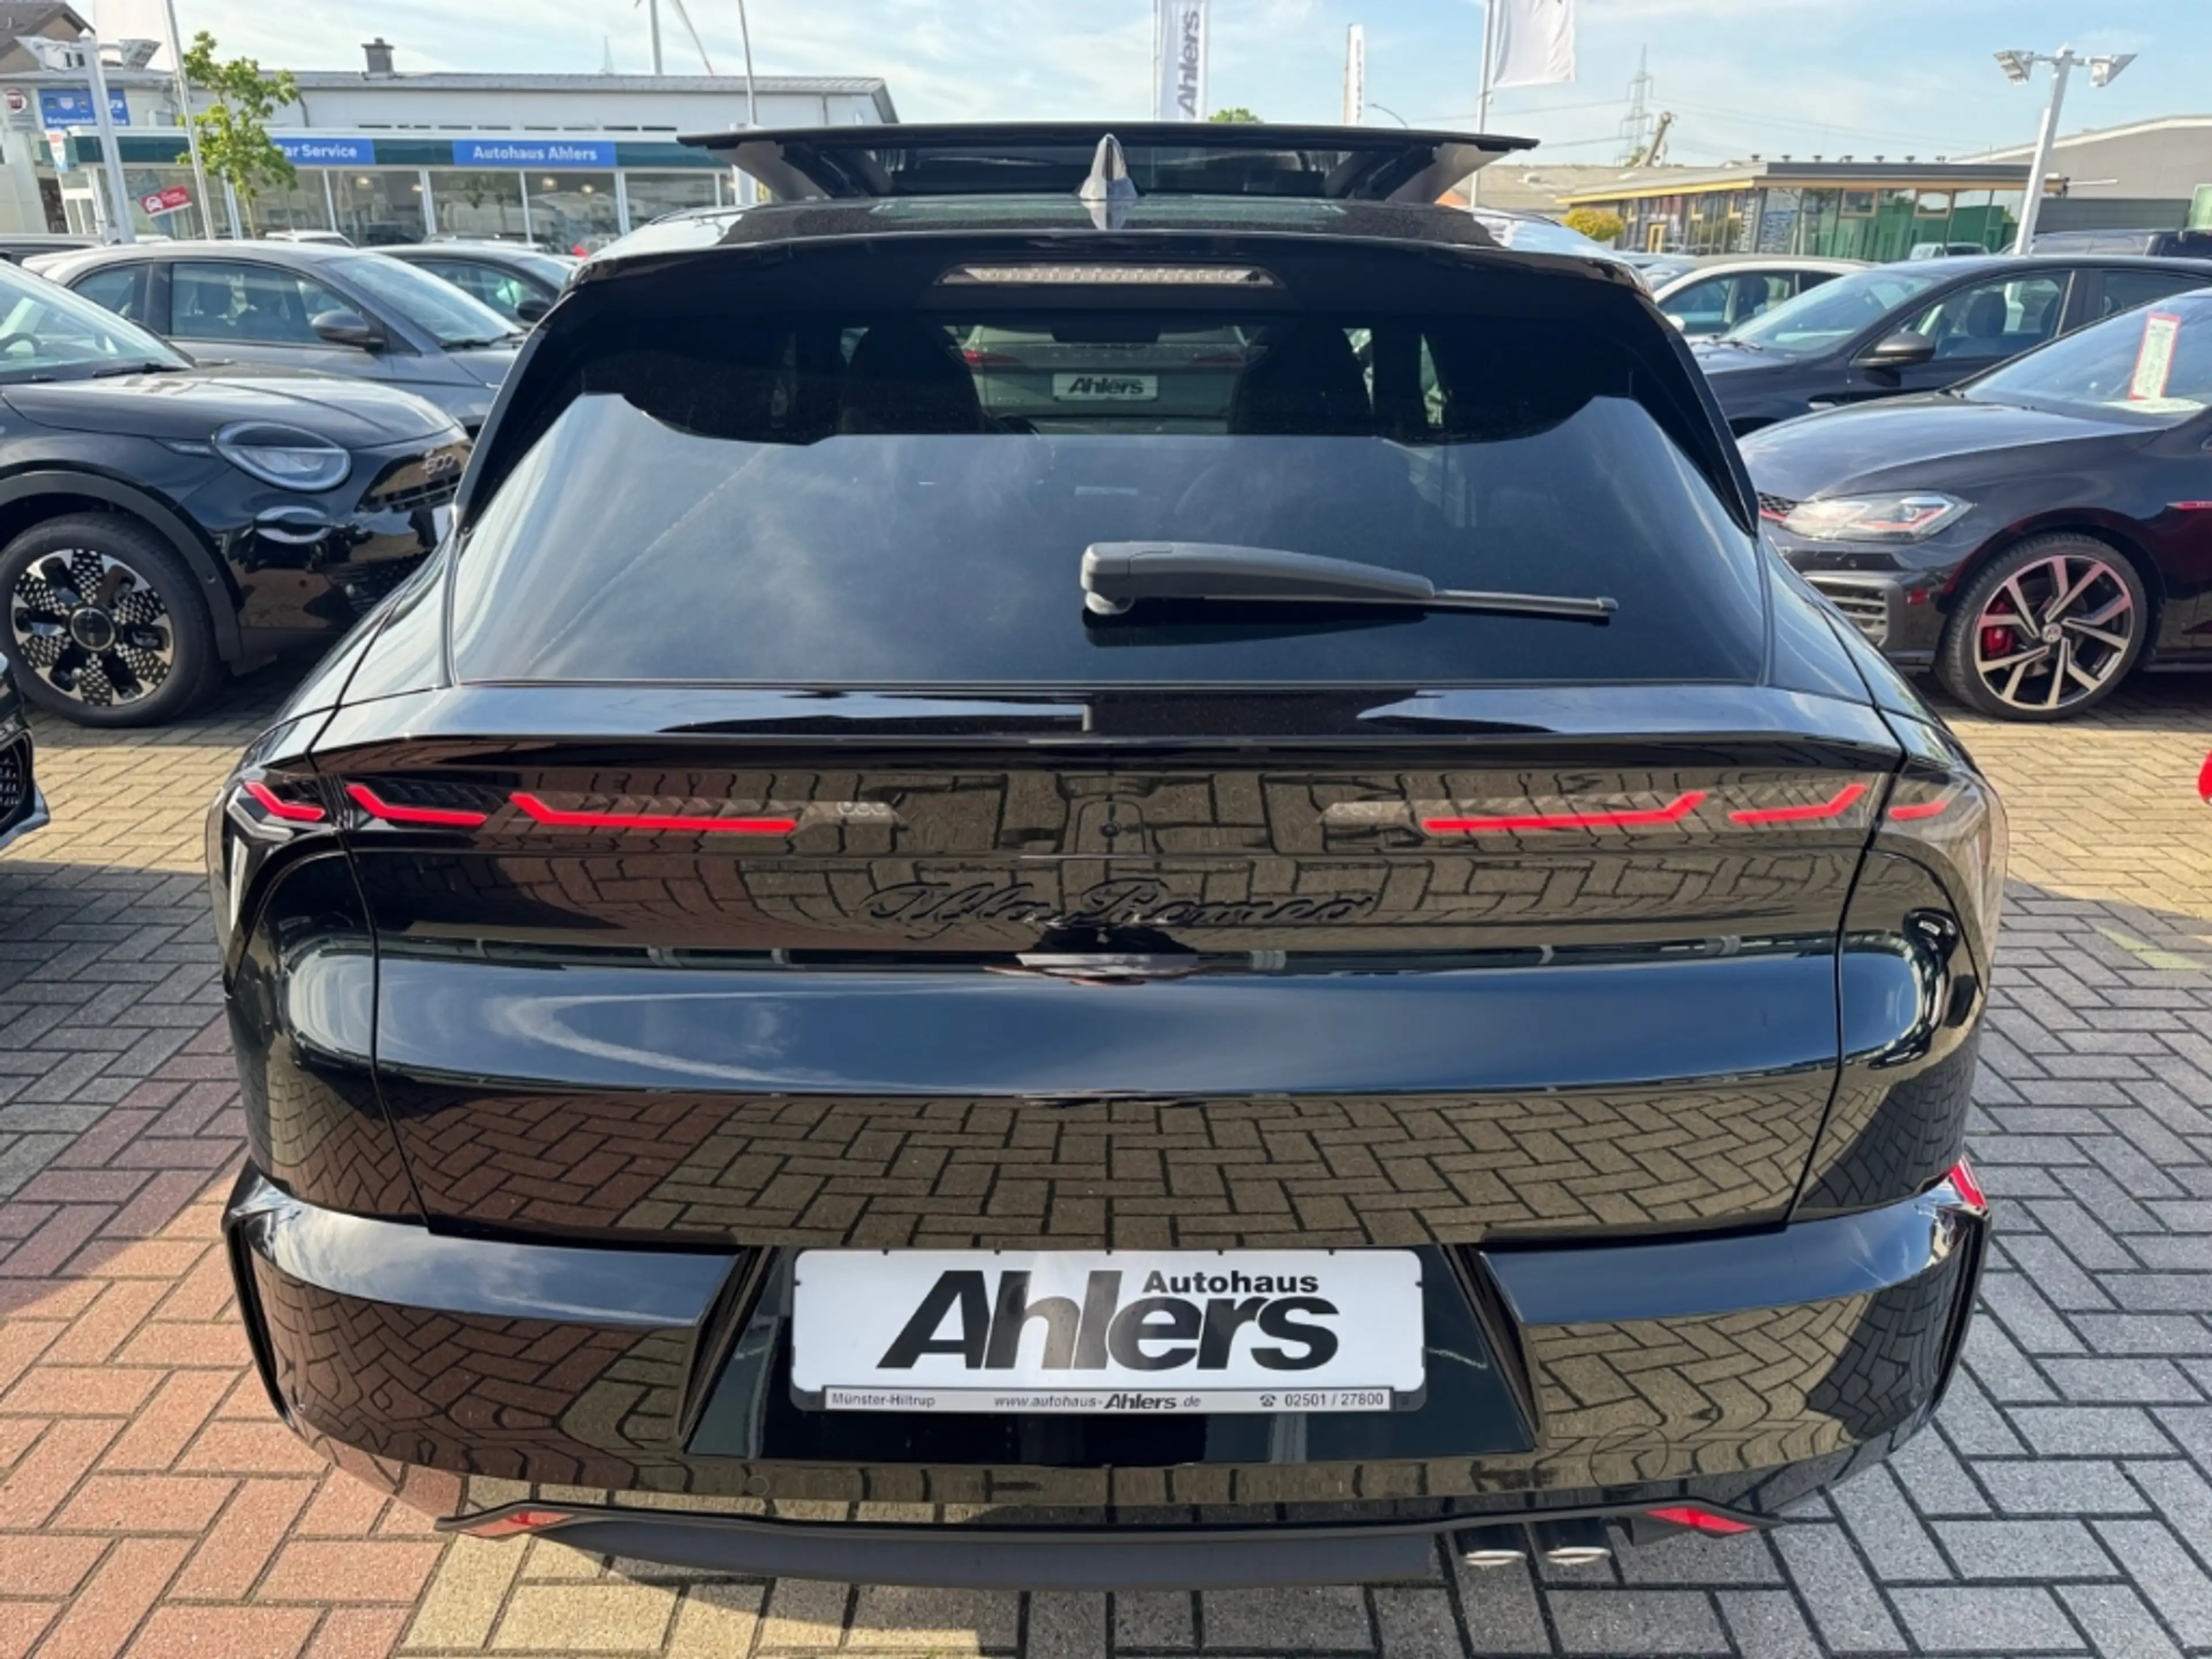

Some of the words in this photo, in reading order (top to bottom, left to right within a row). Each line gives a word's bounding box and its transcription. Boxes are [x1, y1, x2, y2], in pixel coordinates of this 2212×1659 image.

[1177, 10, 1200, 119] Ahlers
[302, 143, 358, 158] Service
[474, 145, 545, 160] Autohaus
[548, 146, 598, 161] Ahlers
[1067, 376, 1145, 395] Ahlers
[1142, 1270, 1320, 1294] Autohaus
[874, 1269, 1340, 1372] Ahlers
[831, 1392, 937, 1408] Münster-Hiltrup
[1284, 1393, 1326, 1407] 02501
[1341, 1392, 1384, 1406] 27800
